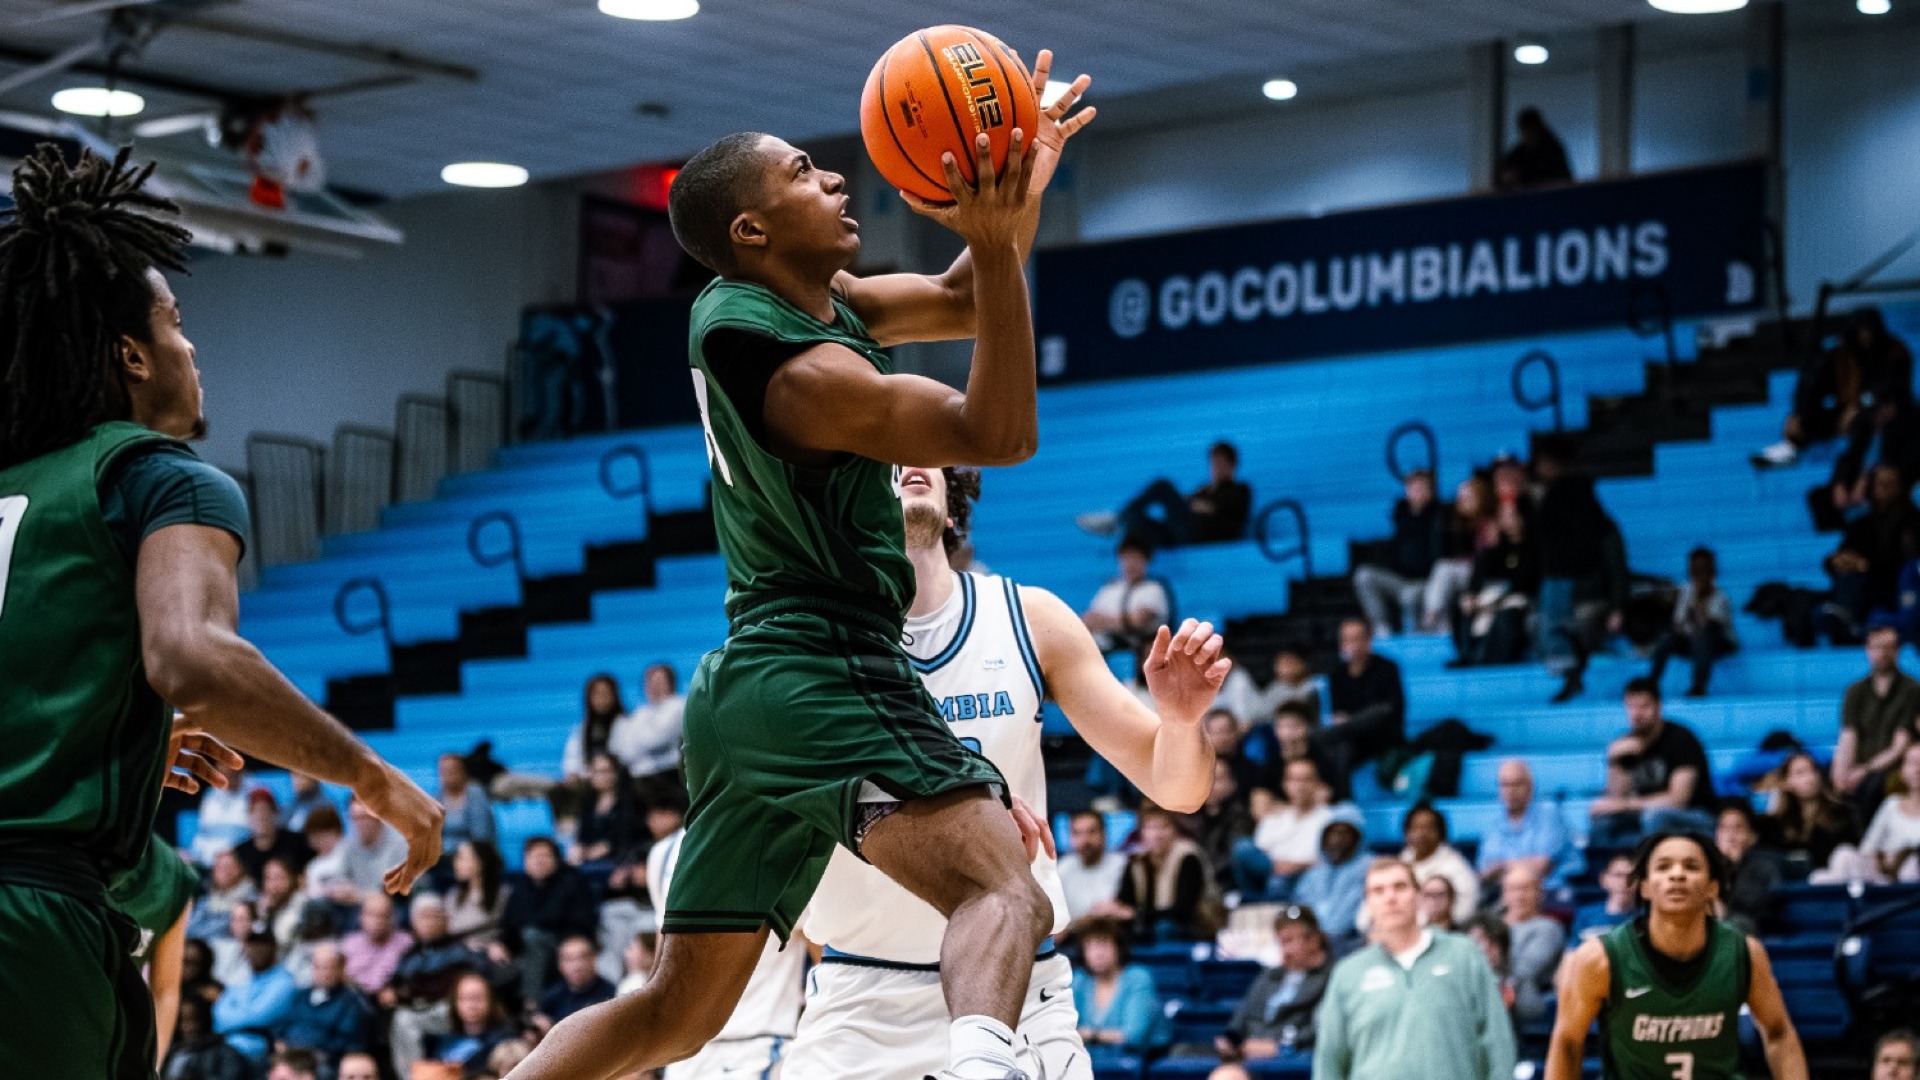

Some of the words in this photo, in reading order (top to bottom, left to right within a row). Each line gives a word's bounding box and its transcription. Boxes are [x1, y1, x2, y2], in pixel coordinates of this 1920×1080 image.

[942, 47, 982, 133] CHAMPIONSHIP
[949, 41, 1004, 131] ELITE
[1632, 1012, 1725, 1043] GRYPHONS
[1664, 1052, 1695, 1080] 3
